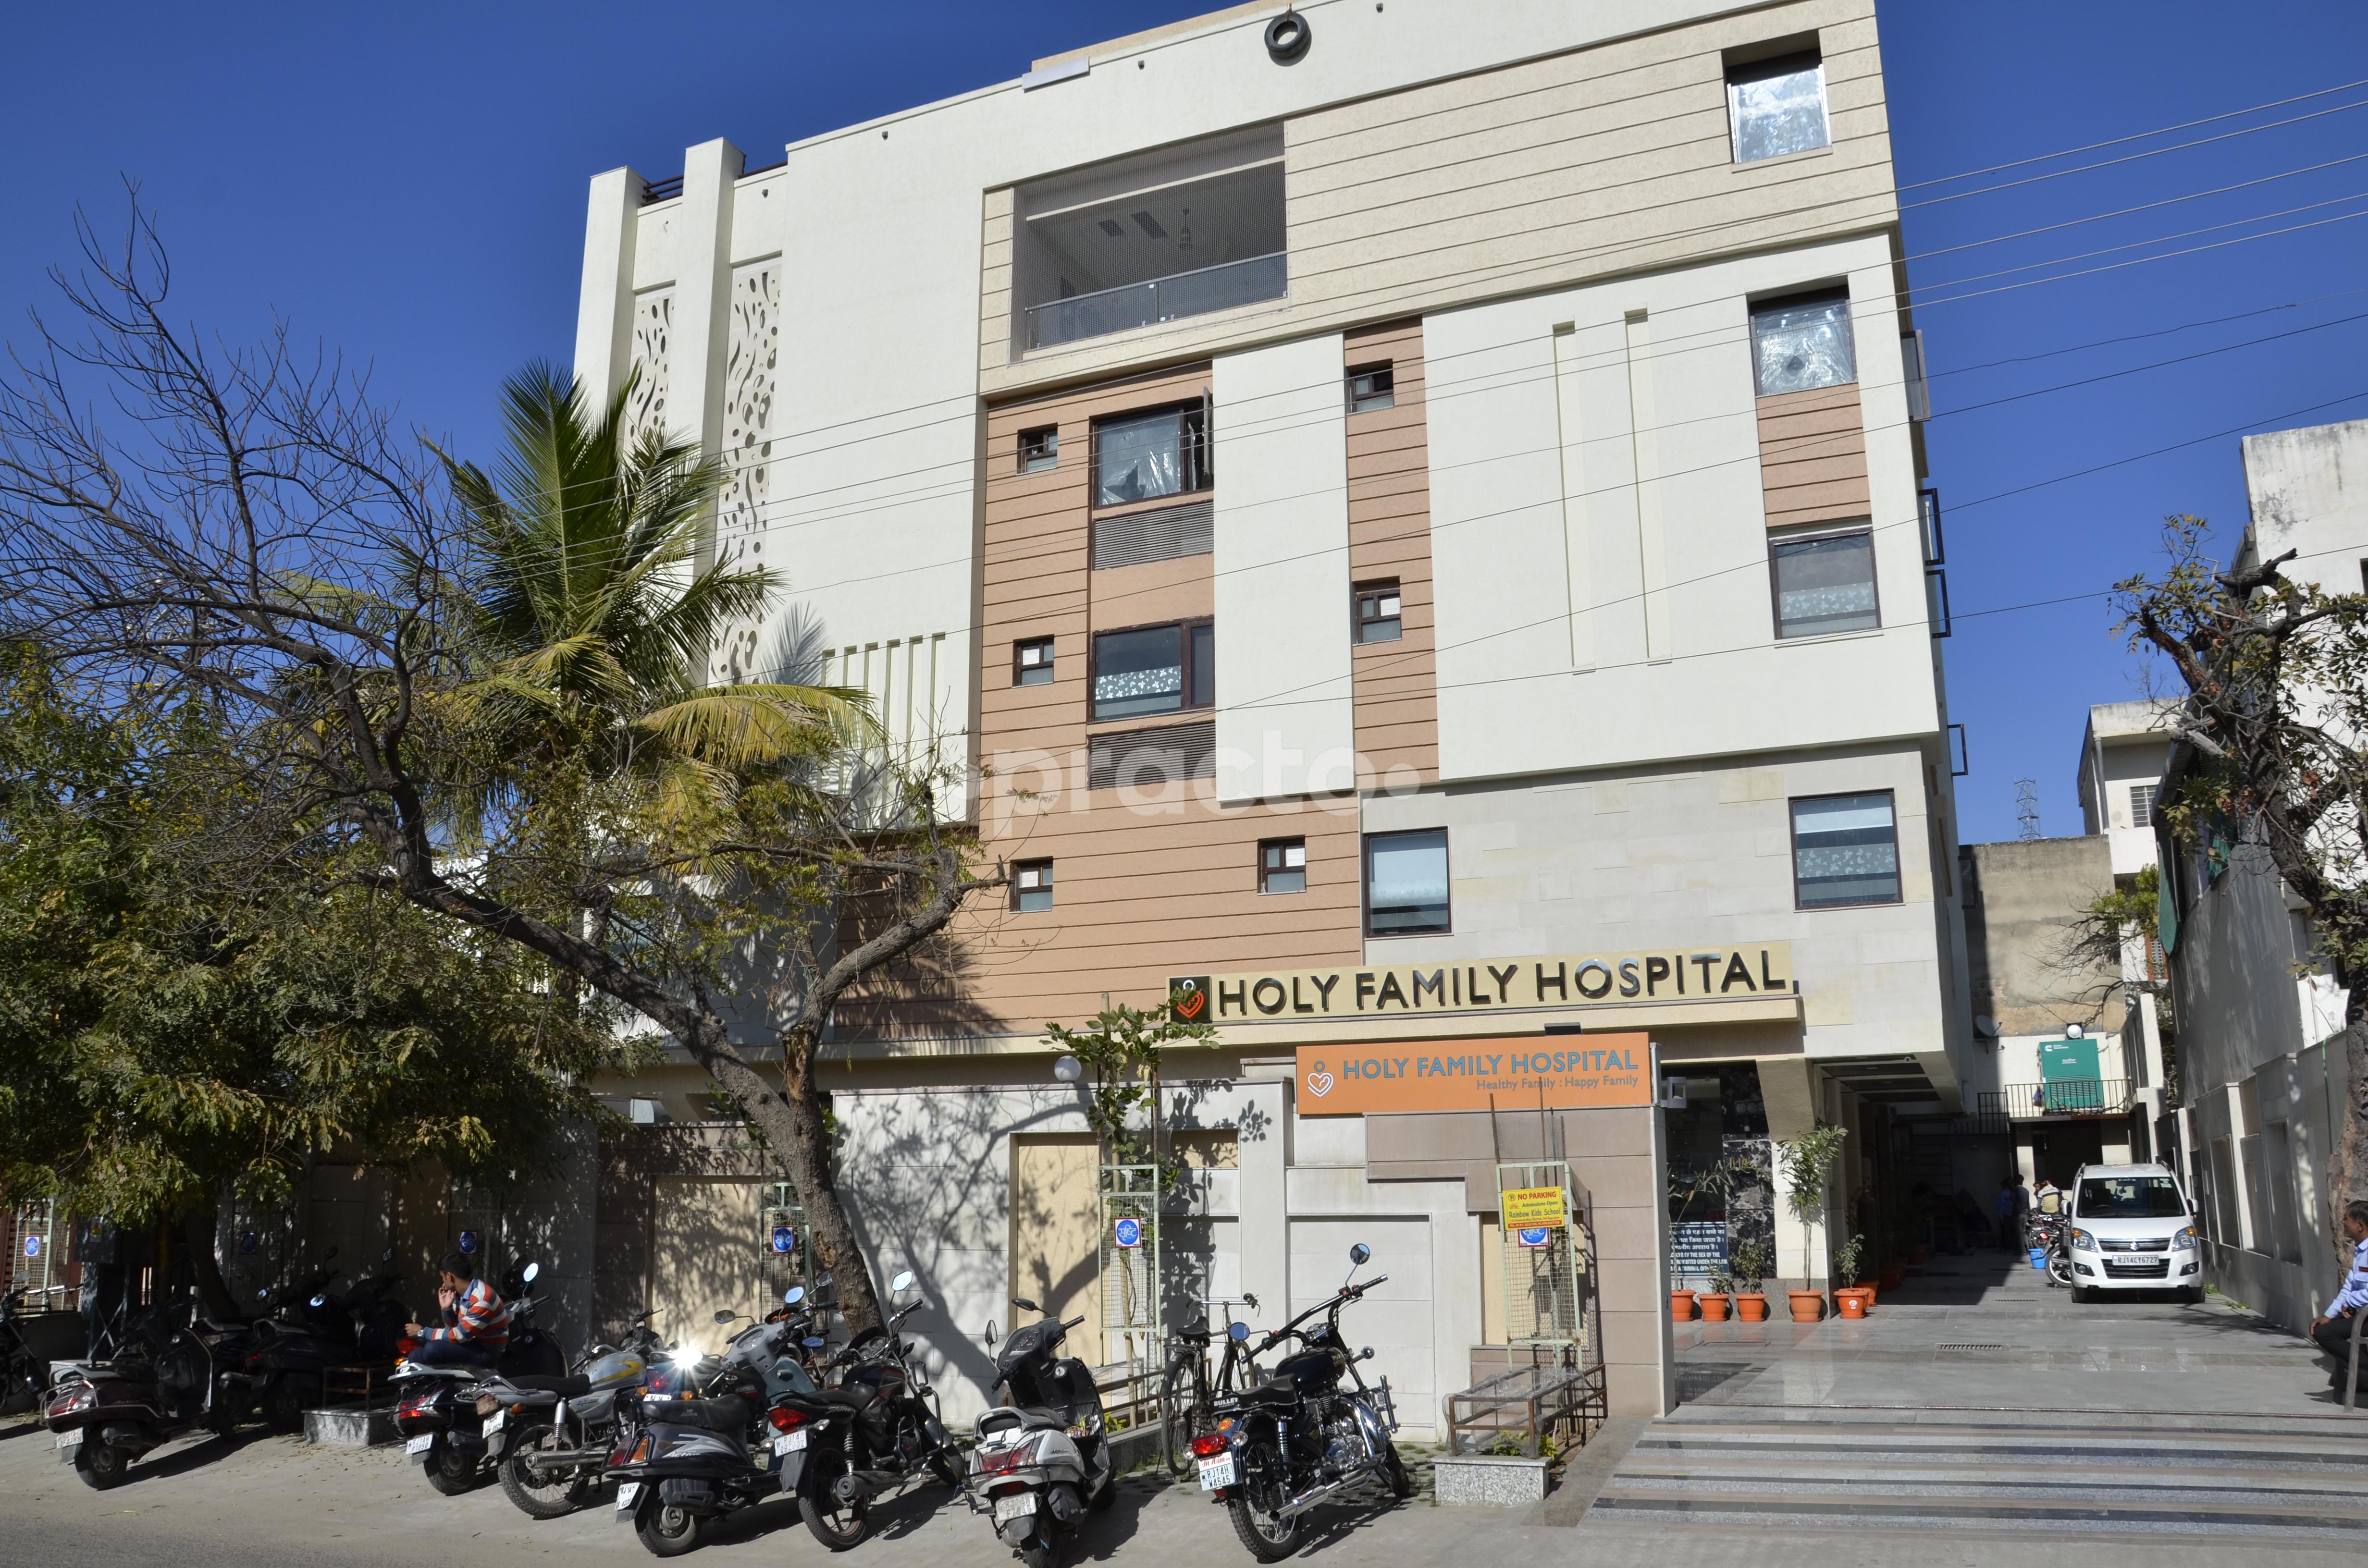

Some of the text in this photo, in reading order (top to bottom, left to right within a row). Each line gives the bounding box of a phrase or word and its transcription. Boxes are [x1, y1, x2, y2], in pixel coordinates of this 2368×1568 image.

[1219, 950, 1786, 1017] HOLY FAMILY HOSPITAL
[1344, 1050, 1638, 1079] HOLY FAMILY HOSPITAL
[1477, 1078, 1518, 1091] Healthy
[1521, 1078, 1556, 1090] Family
[1565, 1076, 1599, 1089] Happy
[1603, 1075, 1638, 1088] Family
[1118, 1224, 1137, 1240] सृष्टि
[1214, 1397, 1238, 1407] BULLET
[1207, 1465, 1229, 1479] RJ14H
[1209, 1475, 1231, 1488] W4545
